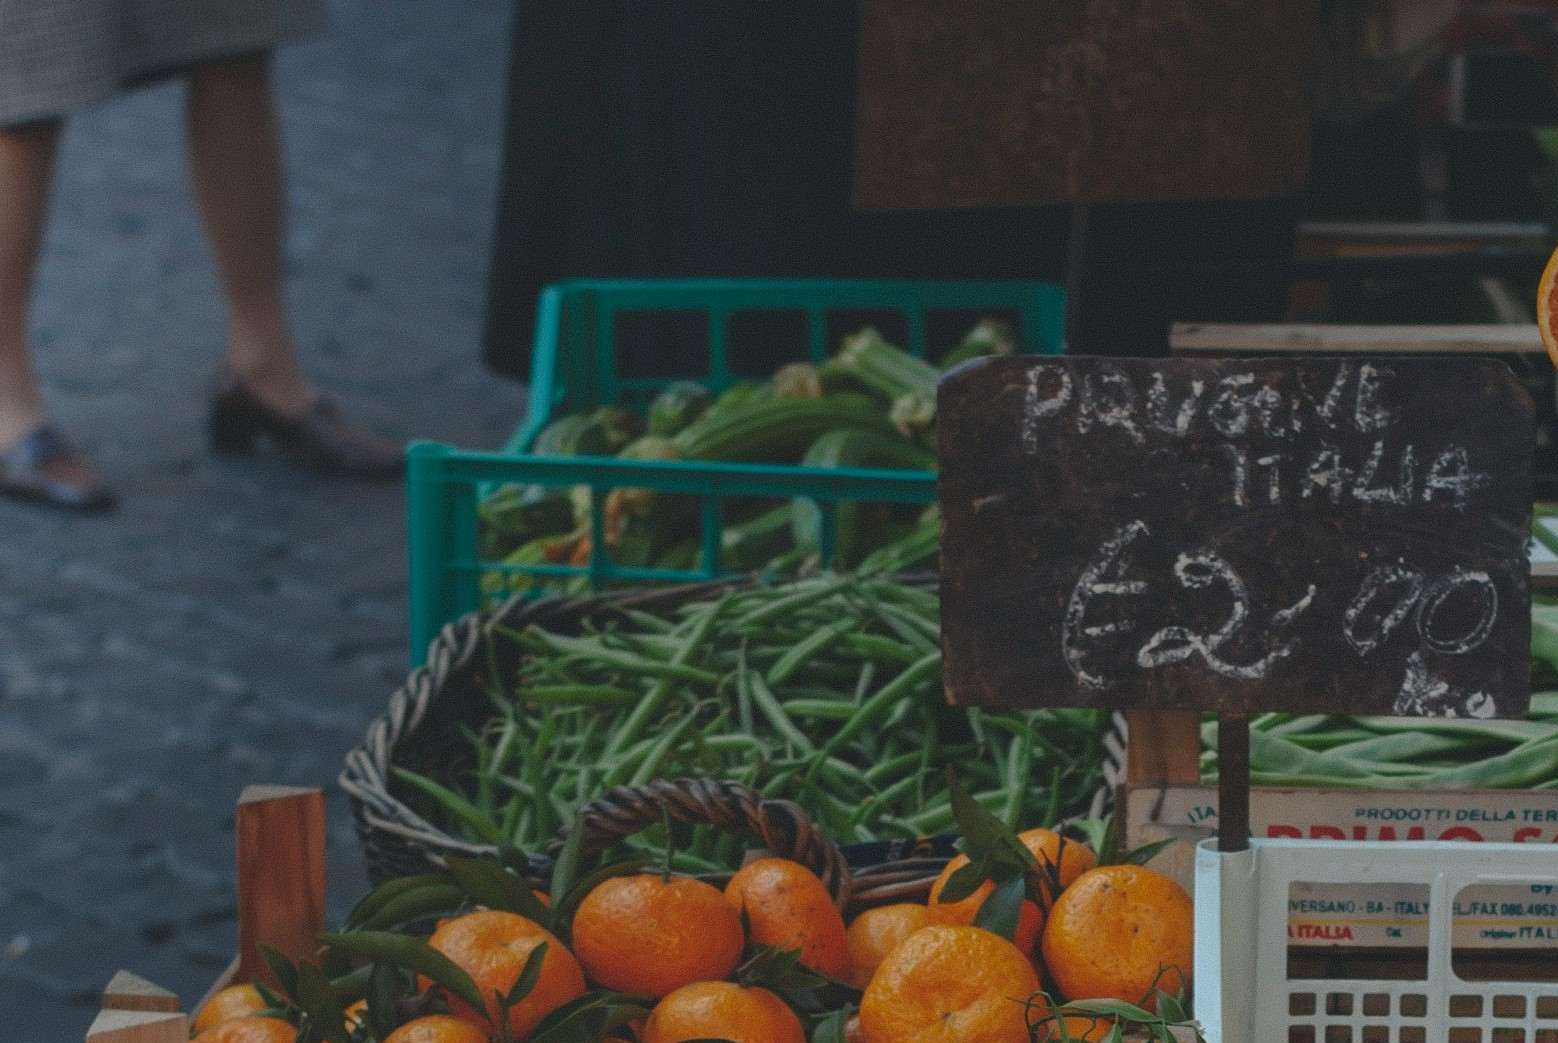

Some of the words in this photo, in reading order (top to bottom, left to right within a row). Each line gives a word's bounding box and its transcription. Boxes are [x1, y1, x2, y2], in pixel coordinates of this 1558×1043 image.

[1354, 807, 1450, 821] PRODOTTI
[1455, 808, 1516, 822] DELLA
[1297, 924, 1354, 940] ITALIA
